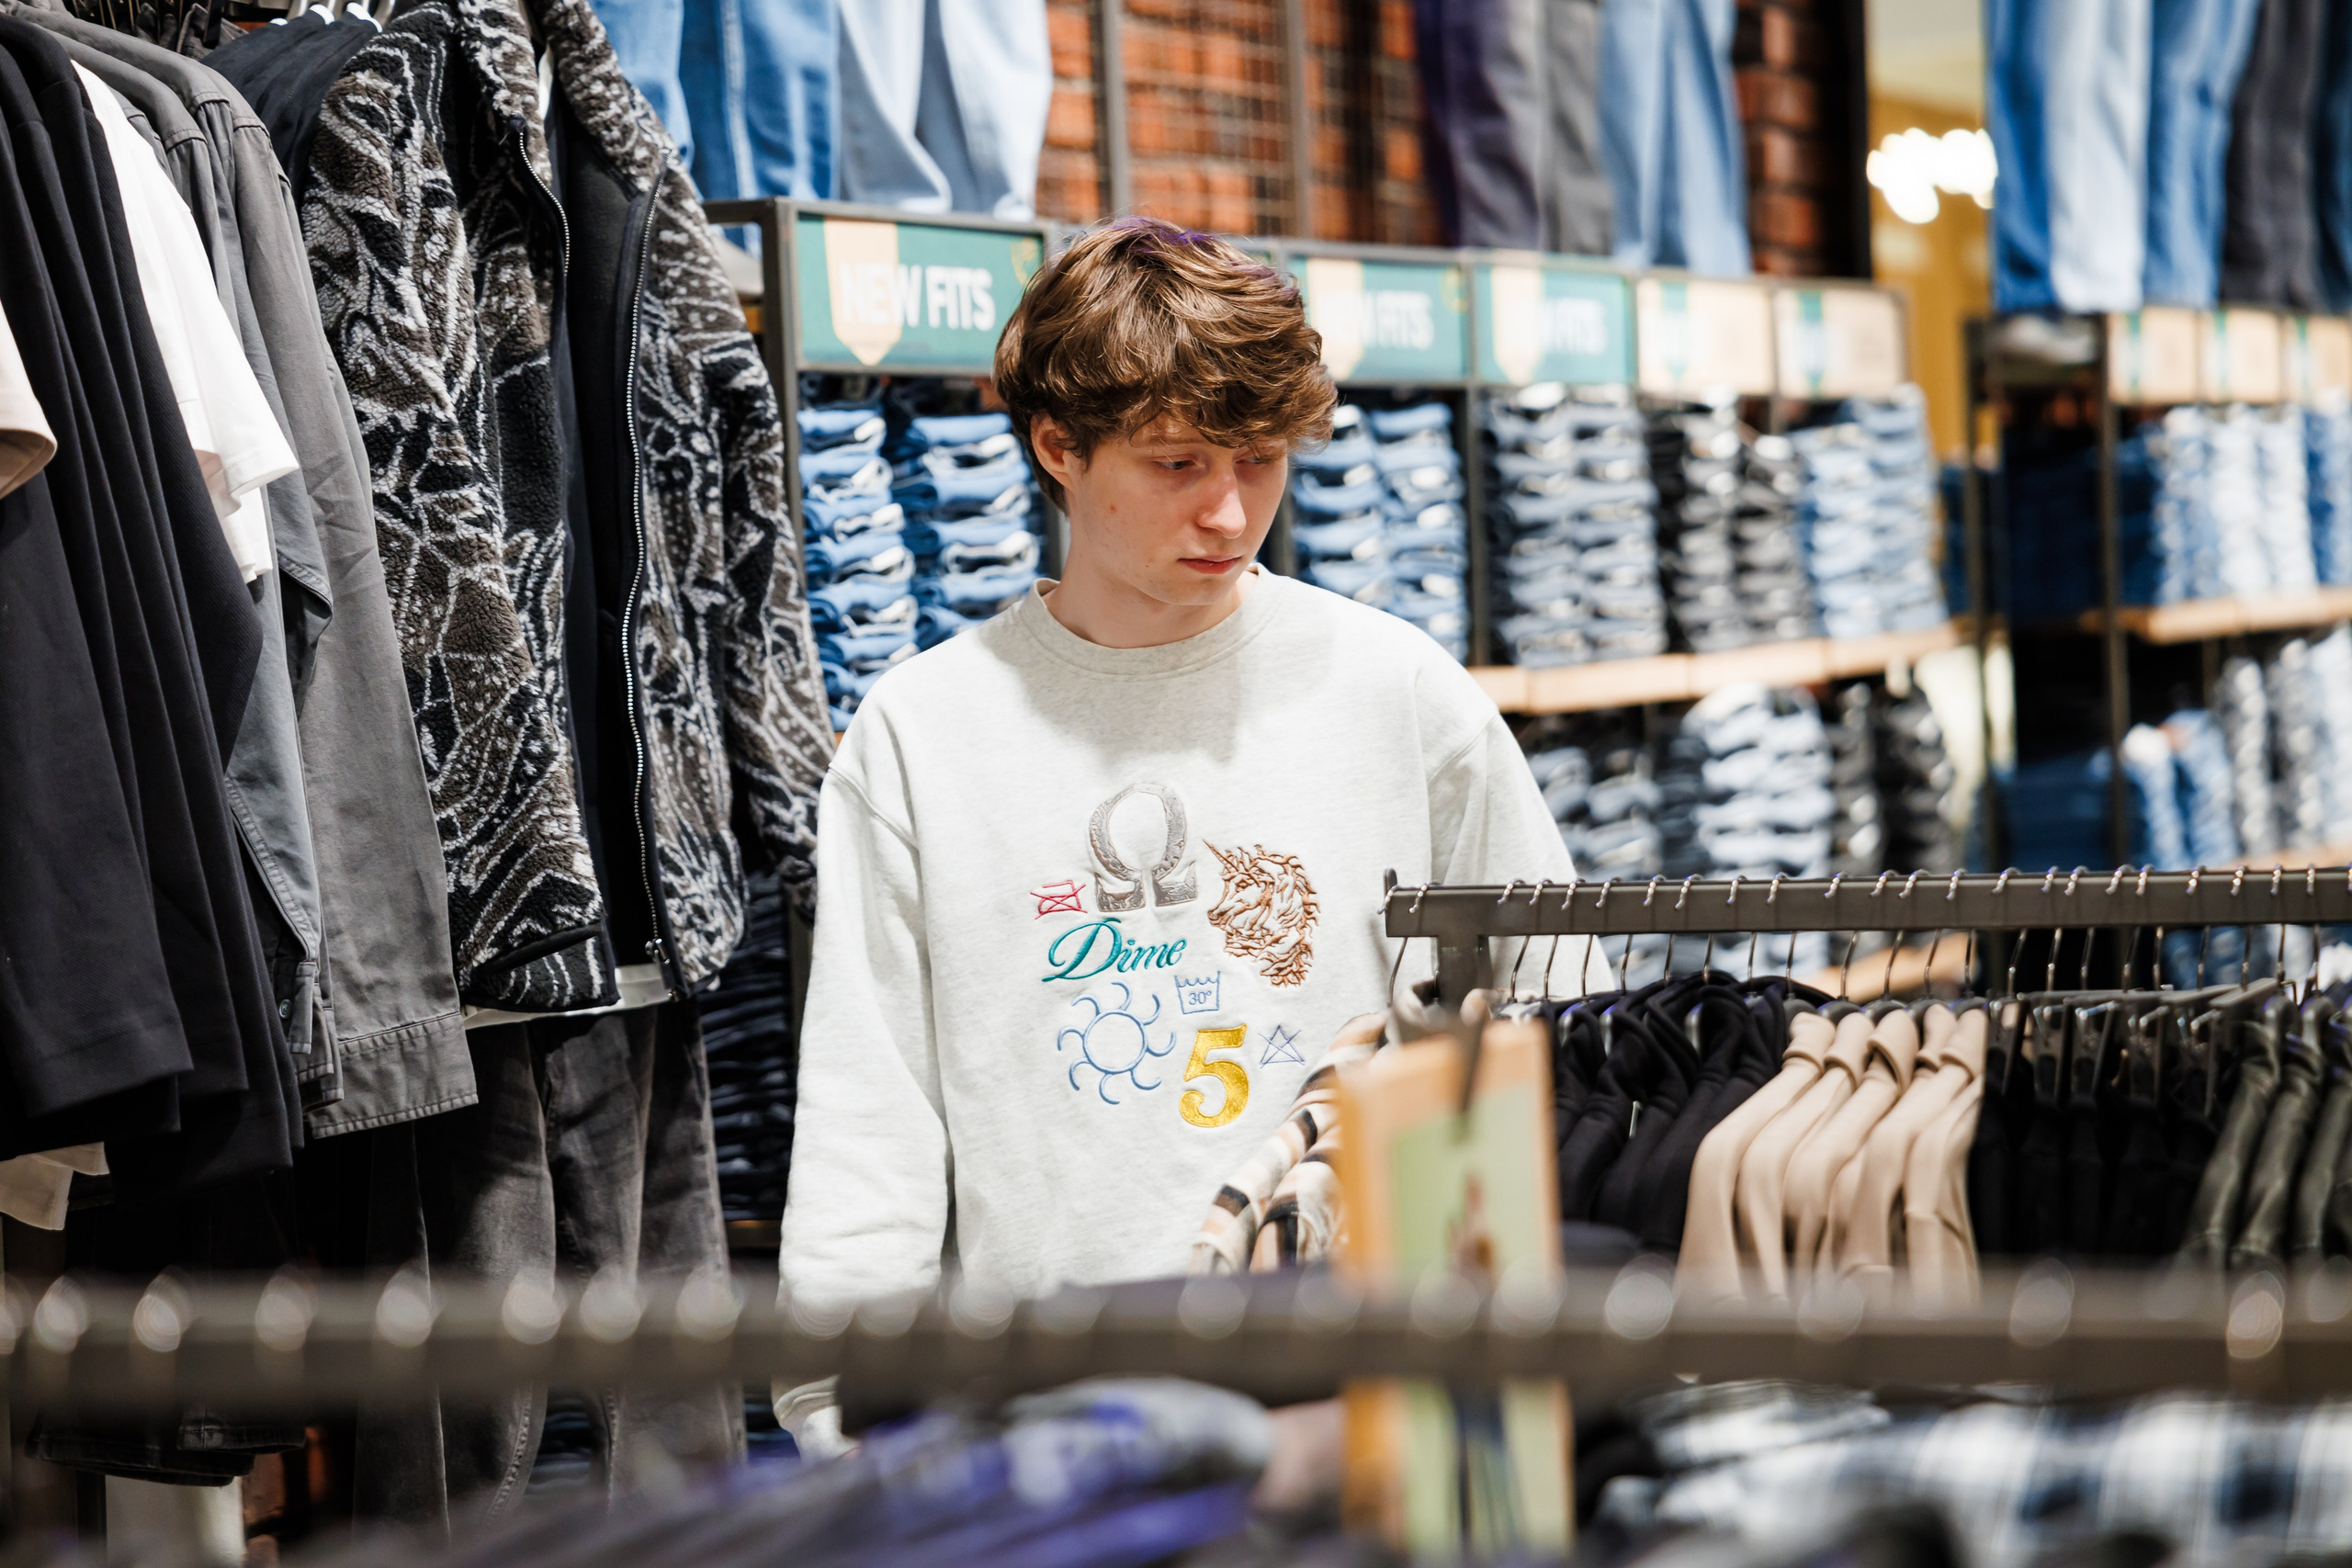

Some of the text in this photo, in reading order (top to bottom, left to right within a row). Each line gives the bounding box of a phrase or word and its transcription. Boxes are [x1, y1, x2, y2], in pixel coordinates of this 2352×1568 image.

[840, 261, 996, 332] NEW FITS
[1042, 918, 1187, 982] Dime
[1188, 990, 1212, 1006] 30°
[1179, 1022, 1250, 1128] 5
